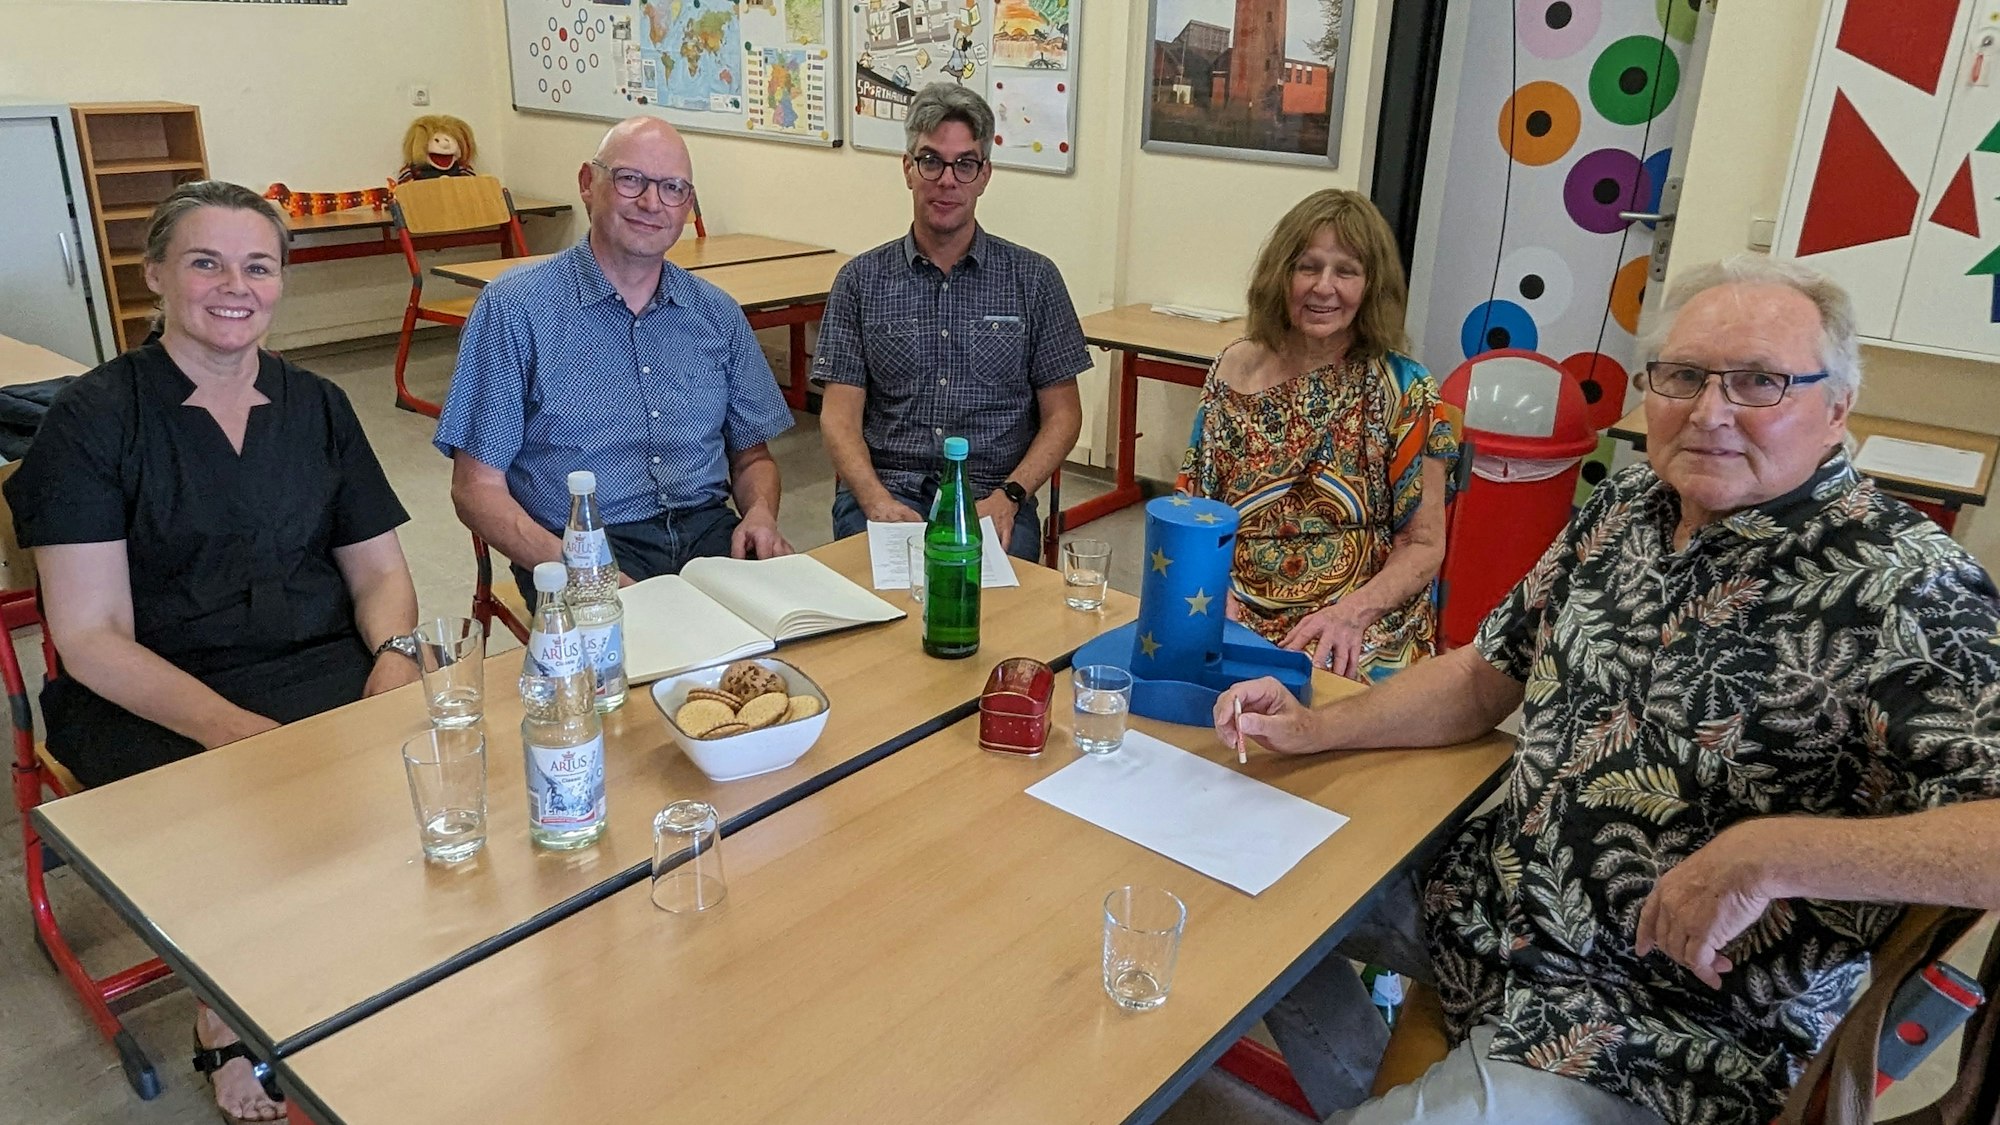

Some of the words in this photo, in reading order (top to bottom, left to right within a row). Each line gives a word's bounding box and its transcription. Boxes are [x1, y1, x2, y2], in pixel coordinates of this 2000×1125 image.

[566, 540, 595, 554] ARTUS
[542, 642, 579, 660] ARTUS
[550, 754, 588, 772] ARTUS
